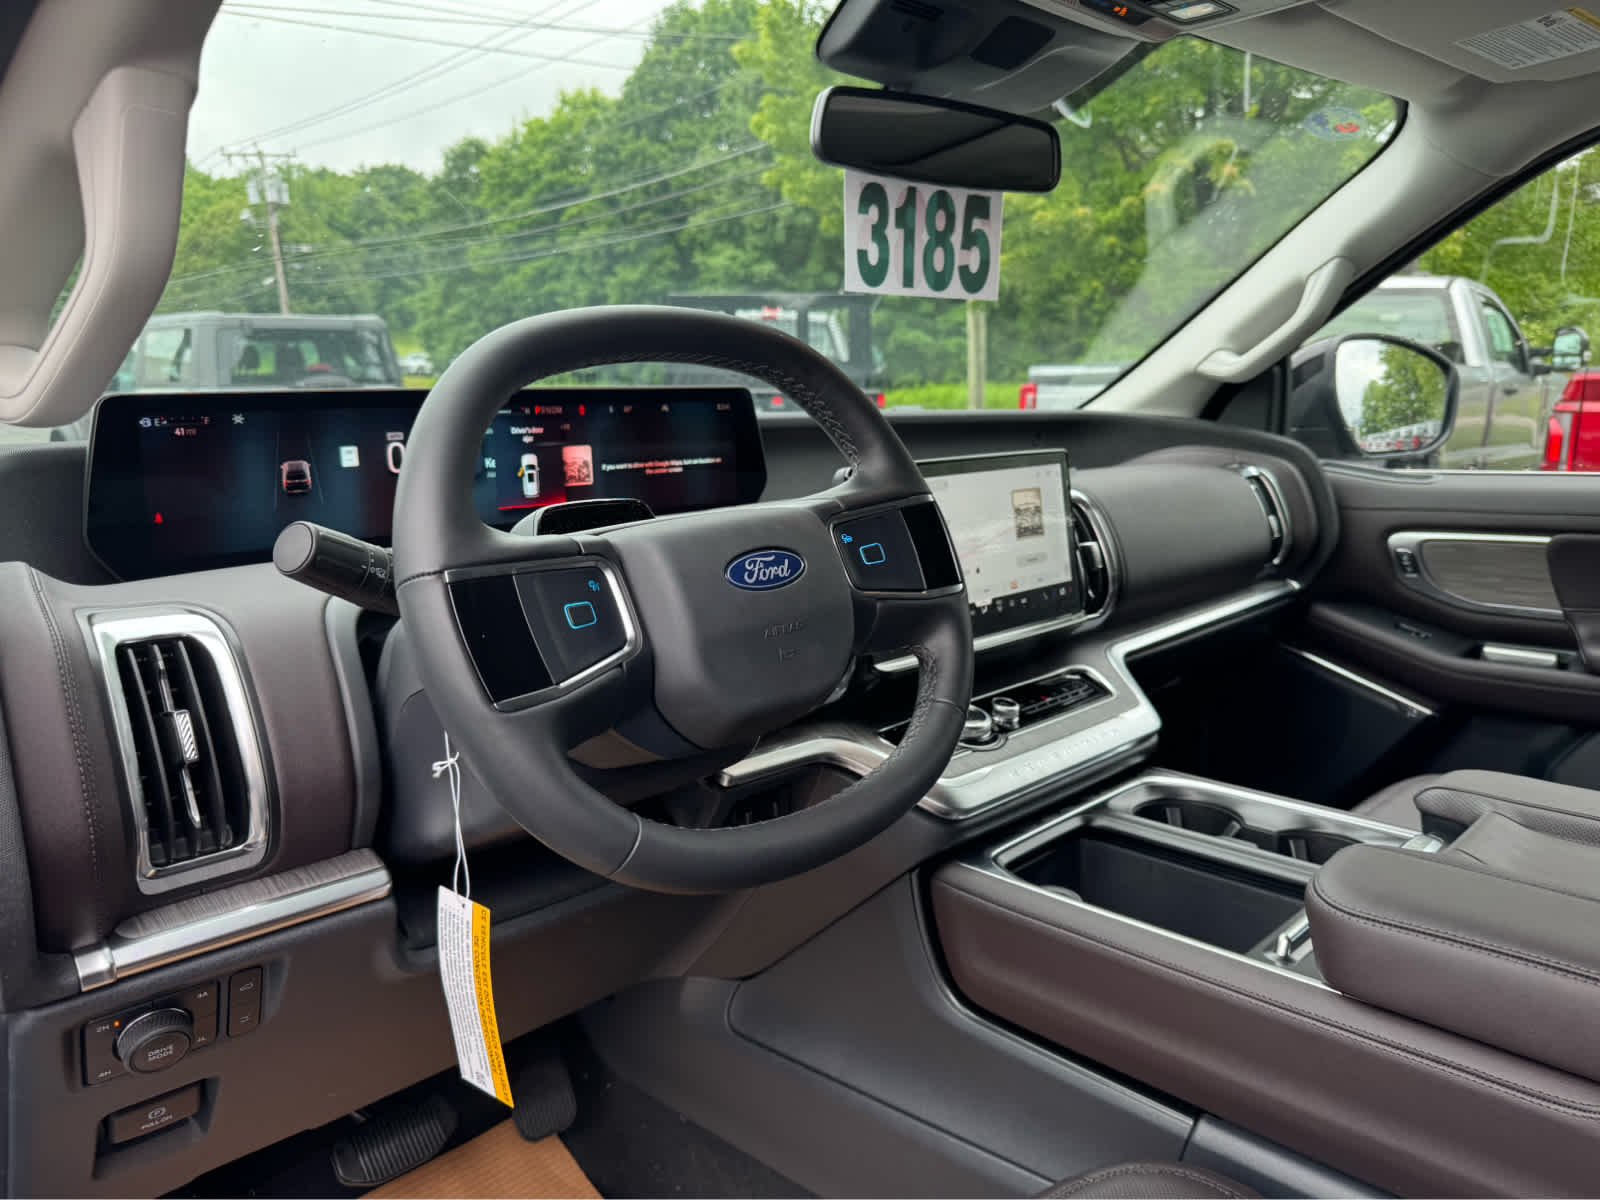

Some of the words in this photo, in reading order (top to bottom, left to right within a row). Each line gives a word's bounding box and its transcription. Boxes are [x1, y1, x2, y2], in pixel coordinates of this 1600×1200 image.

[857, 181, 991, 294] 3185
[744, 555, 790, 583] Ford
[148, 1045, 174, 1057] DRIVE
[148, 1050, 174, 1061] MODE
